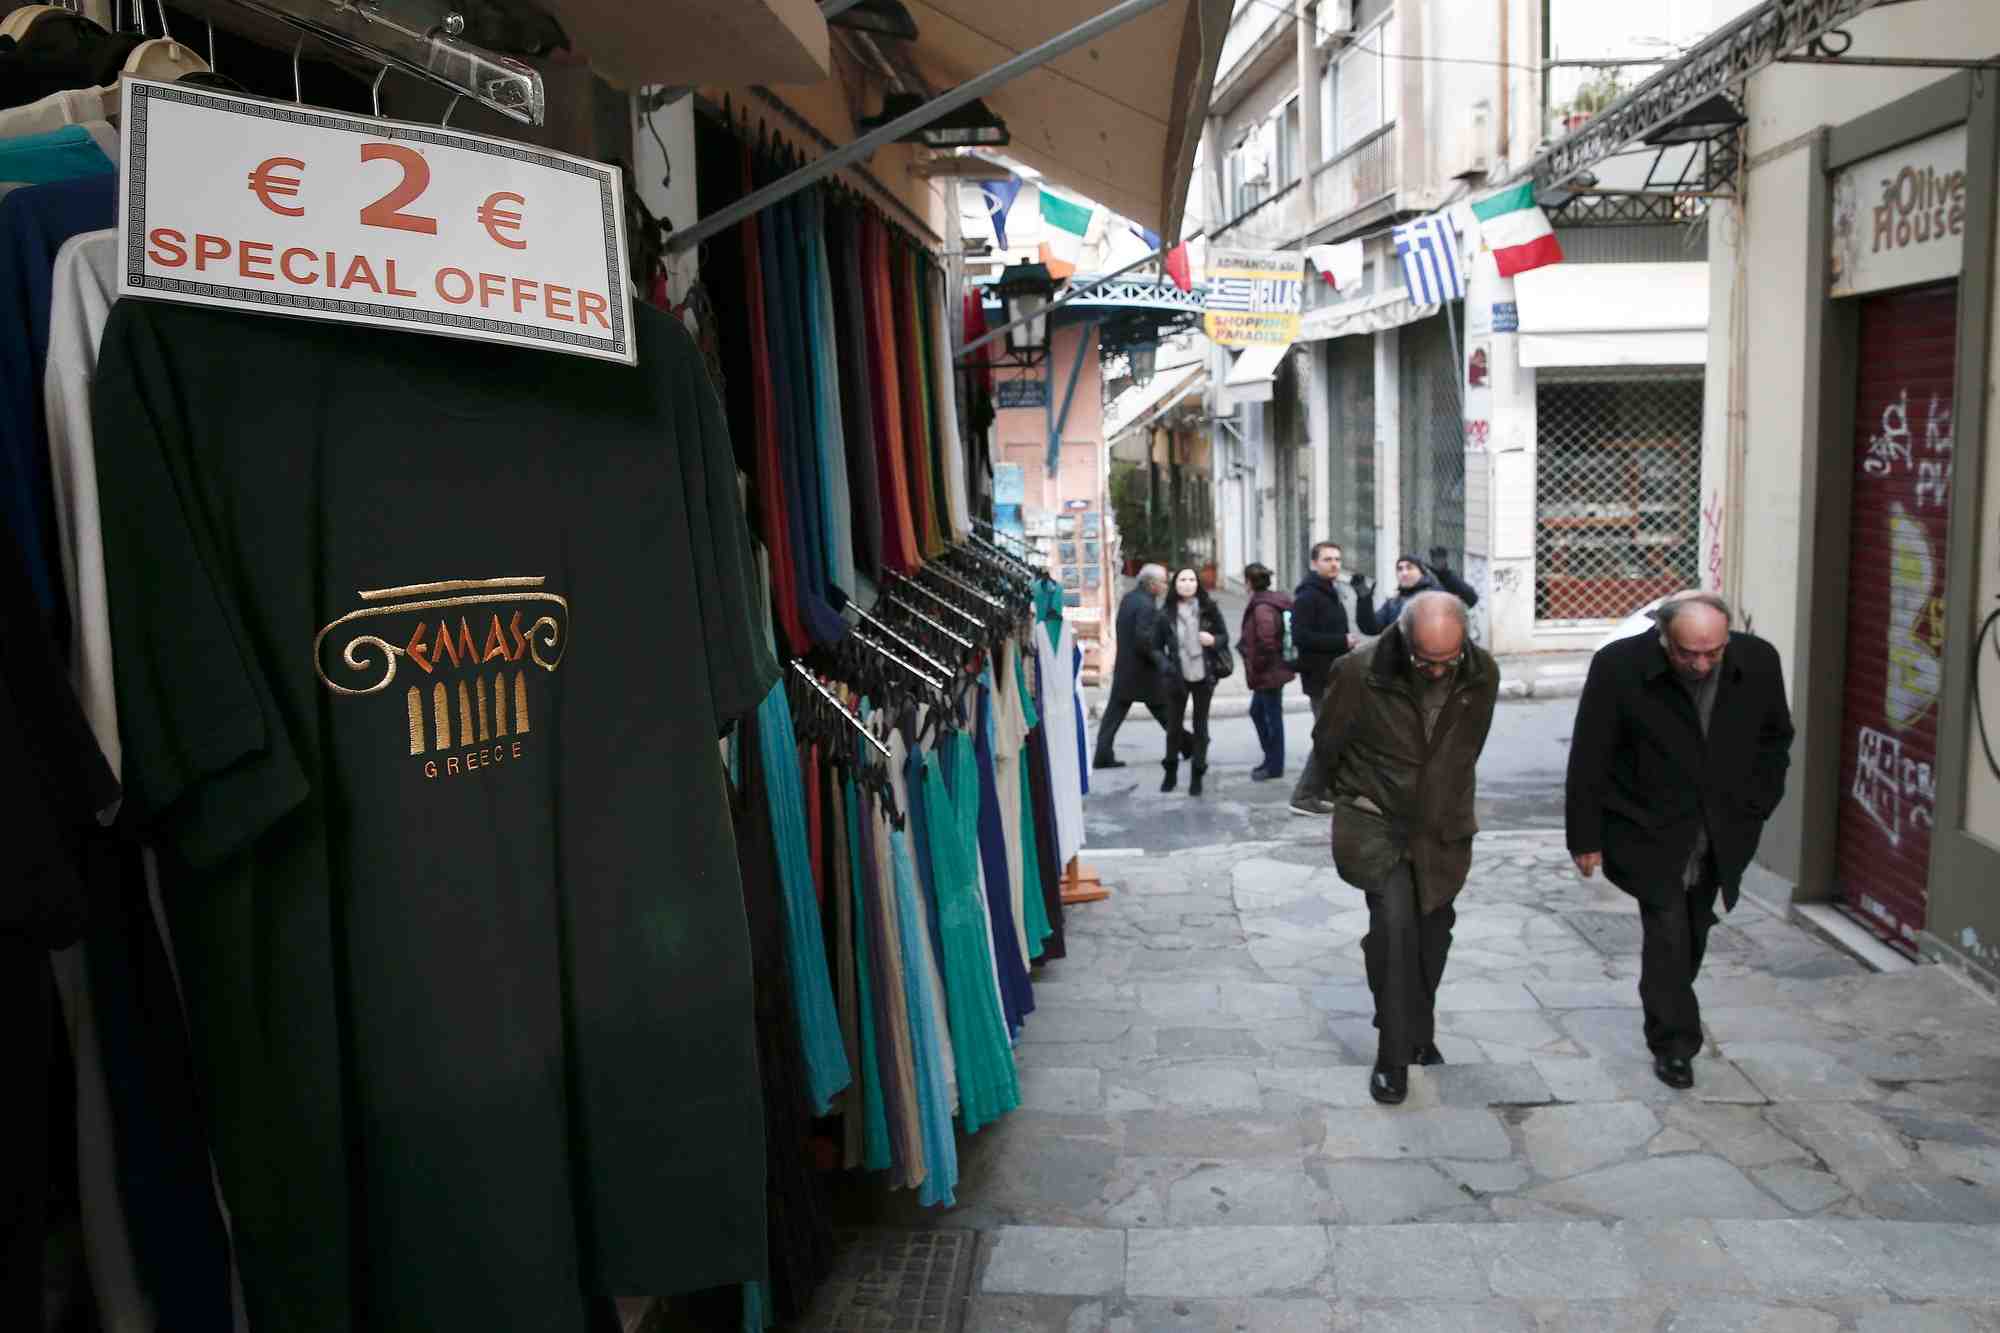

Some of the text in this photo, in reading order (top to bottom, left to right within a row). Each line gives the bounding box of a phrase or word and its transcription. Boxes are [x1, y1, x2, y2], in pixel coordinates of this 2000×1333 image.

[359, 142, 438, 236] 2
[1896, 164, 1967, 216] Olive
[1872, 204, 1966, 254] House
[147, 227, 610, 330] SPECIAL OFFER
[424, 741, 521, 779] GREECE
